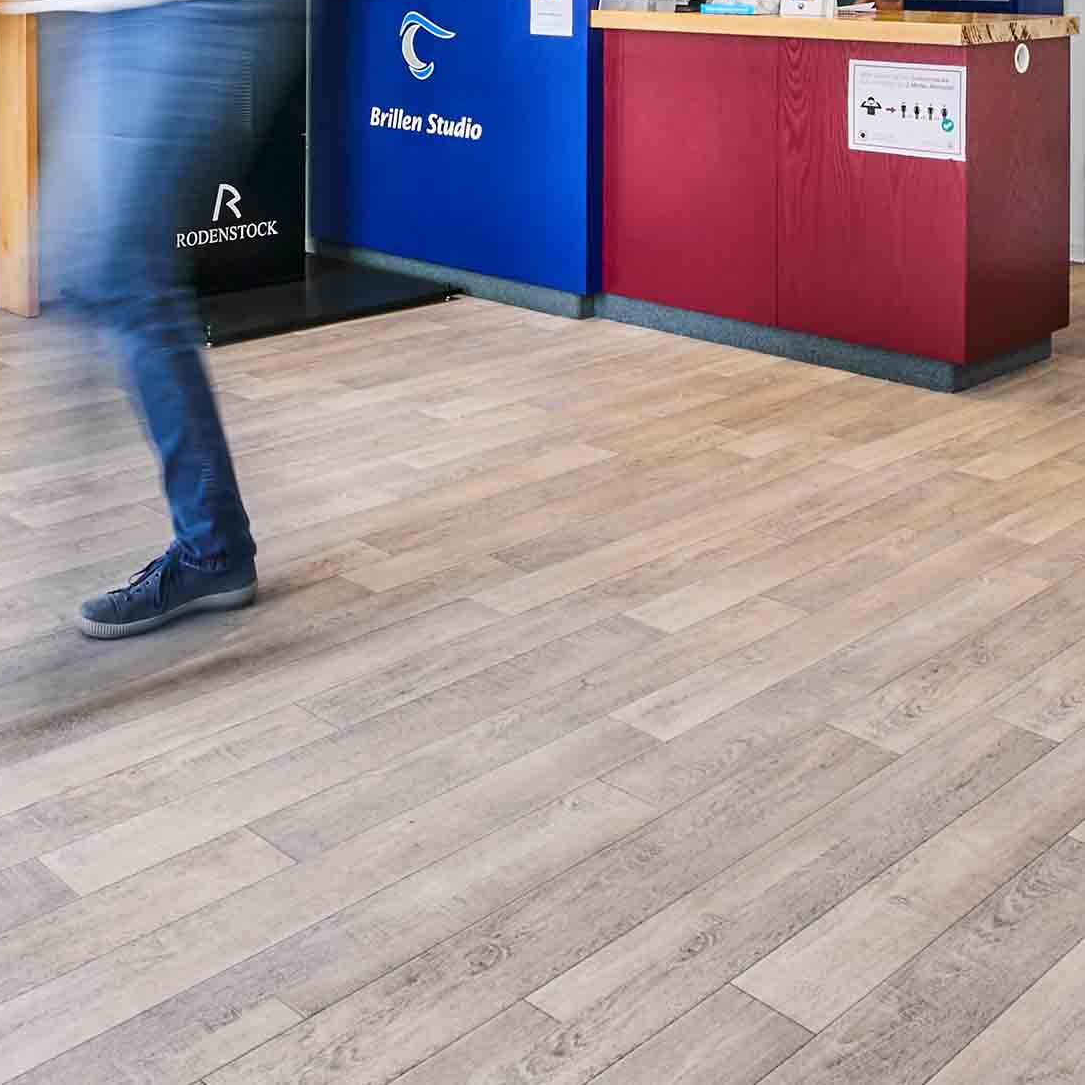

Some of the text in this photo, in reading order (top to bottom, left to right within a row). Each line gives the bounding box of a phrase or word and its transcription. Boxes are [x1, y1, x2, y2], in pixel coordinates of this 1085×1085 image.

[370, 107, 482, 140] Brillen Studio
[212, 183, 242, 222] R
[176, 220, 279, 248] RODENSTOCK
